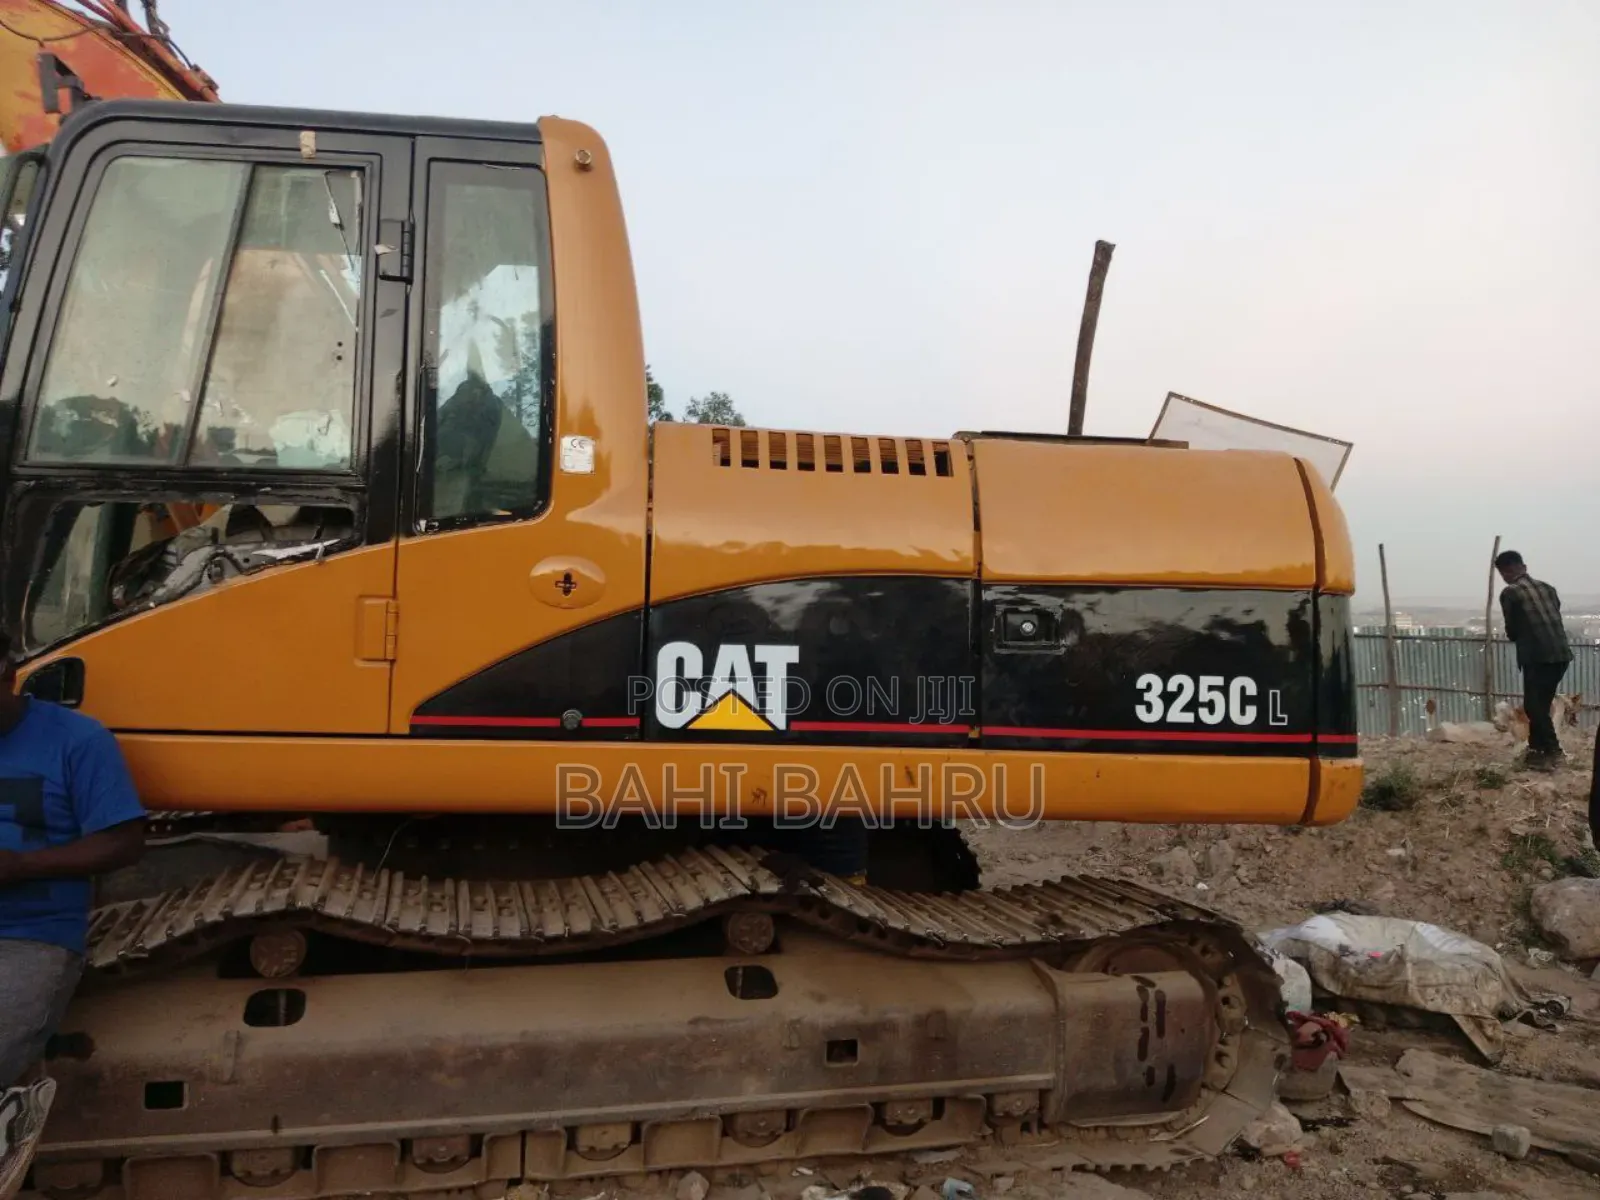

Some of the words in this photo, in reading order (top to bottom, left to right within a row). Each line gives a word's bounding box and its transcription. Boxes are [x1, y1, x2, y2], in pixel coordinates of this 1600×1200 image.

[655, 641, 799, 731] CAT
[1135, 673, 1258, 725] 325C
[1269, 689, 1289, 726] L
